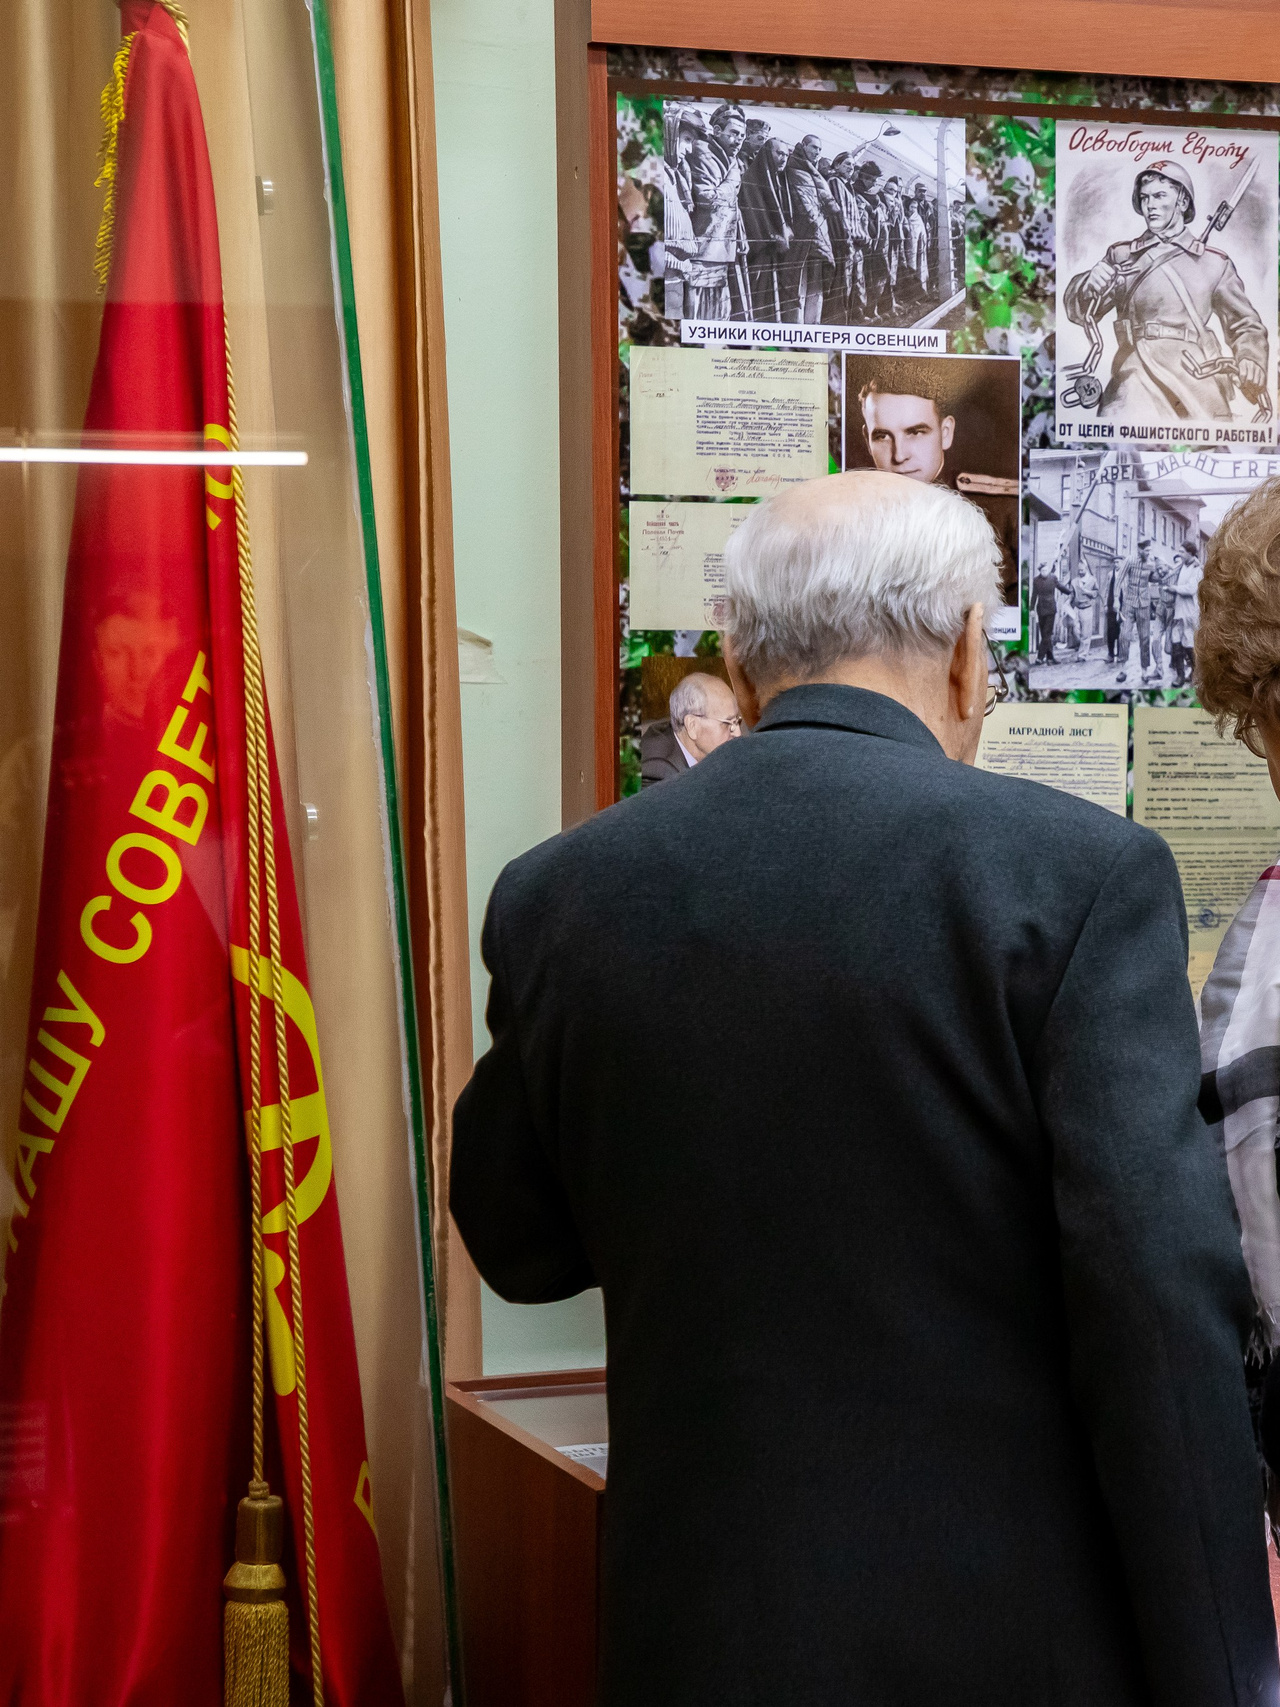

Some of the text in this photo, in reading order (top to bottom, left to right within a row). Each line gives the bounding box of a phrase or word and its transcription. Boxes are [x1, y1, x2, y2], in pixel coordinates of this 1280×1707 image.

[1068, 126, 1250, 169] Освободим Европу
[688, 325, 940, 350] УЗНИКИ КОНЦЛАГЕРЯ ОСВЕНЦИМ
[1059, 421, 1273, 443] ОТ ЦЕПЕЙ ФАШИСТСКОГО РАБСТВА!
[1156, 451, 1219, 478] MACHT
[1008, 725, 1094, 737] НАГРАДНОЙ ЛИСТ
